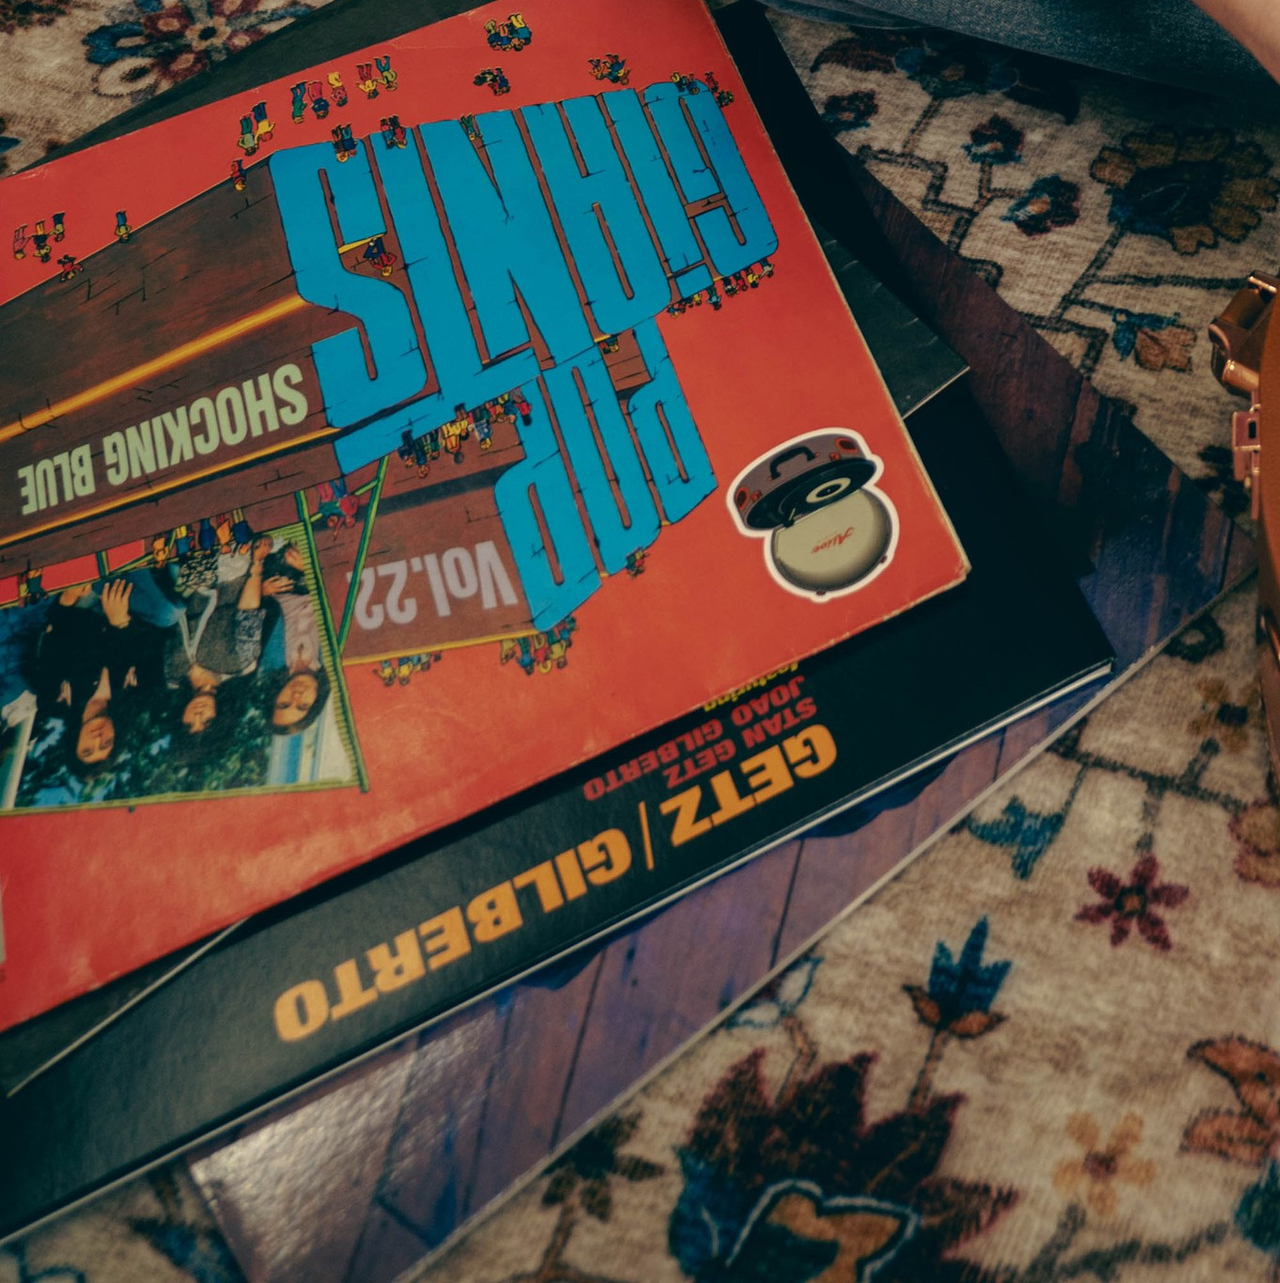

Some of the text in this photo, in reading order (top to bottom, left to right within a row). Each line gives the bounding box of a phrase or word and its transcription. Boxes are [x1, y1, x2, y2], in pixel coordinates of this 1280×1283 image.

[17, 363, 309, 516] SHOCKING BLUE
[494, 317, 719, 633] POP
[346, 540, 519, 631] Vol.22
[582, 675, 805, 801] JOAO GILBERTO
[662, 697, 818, 788] STAN GETZ
[273, 828, 632, 1043] GILBERTO
